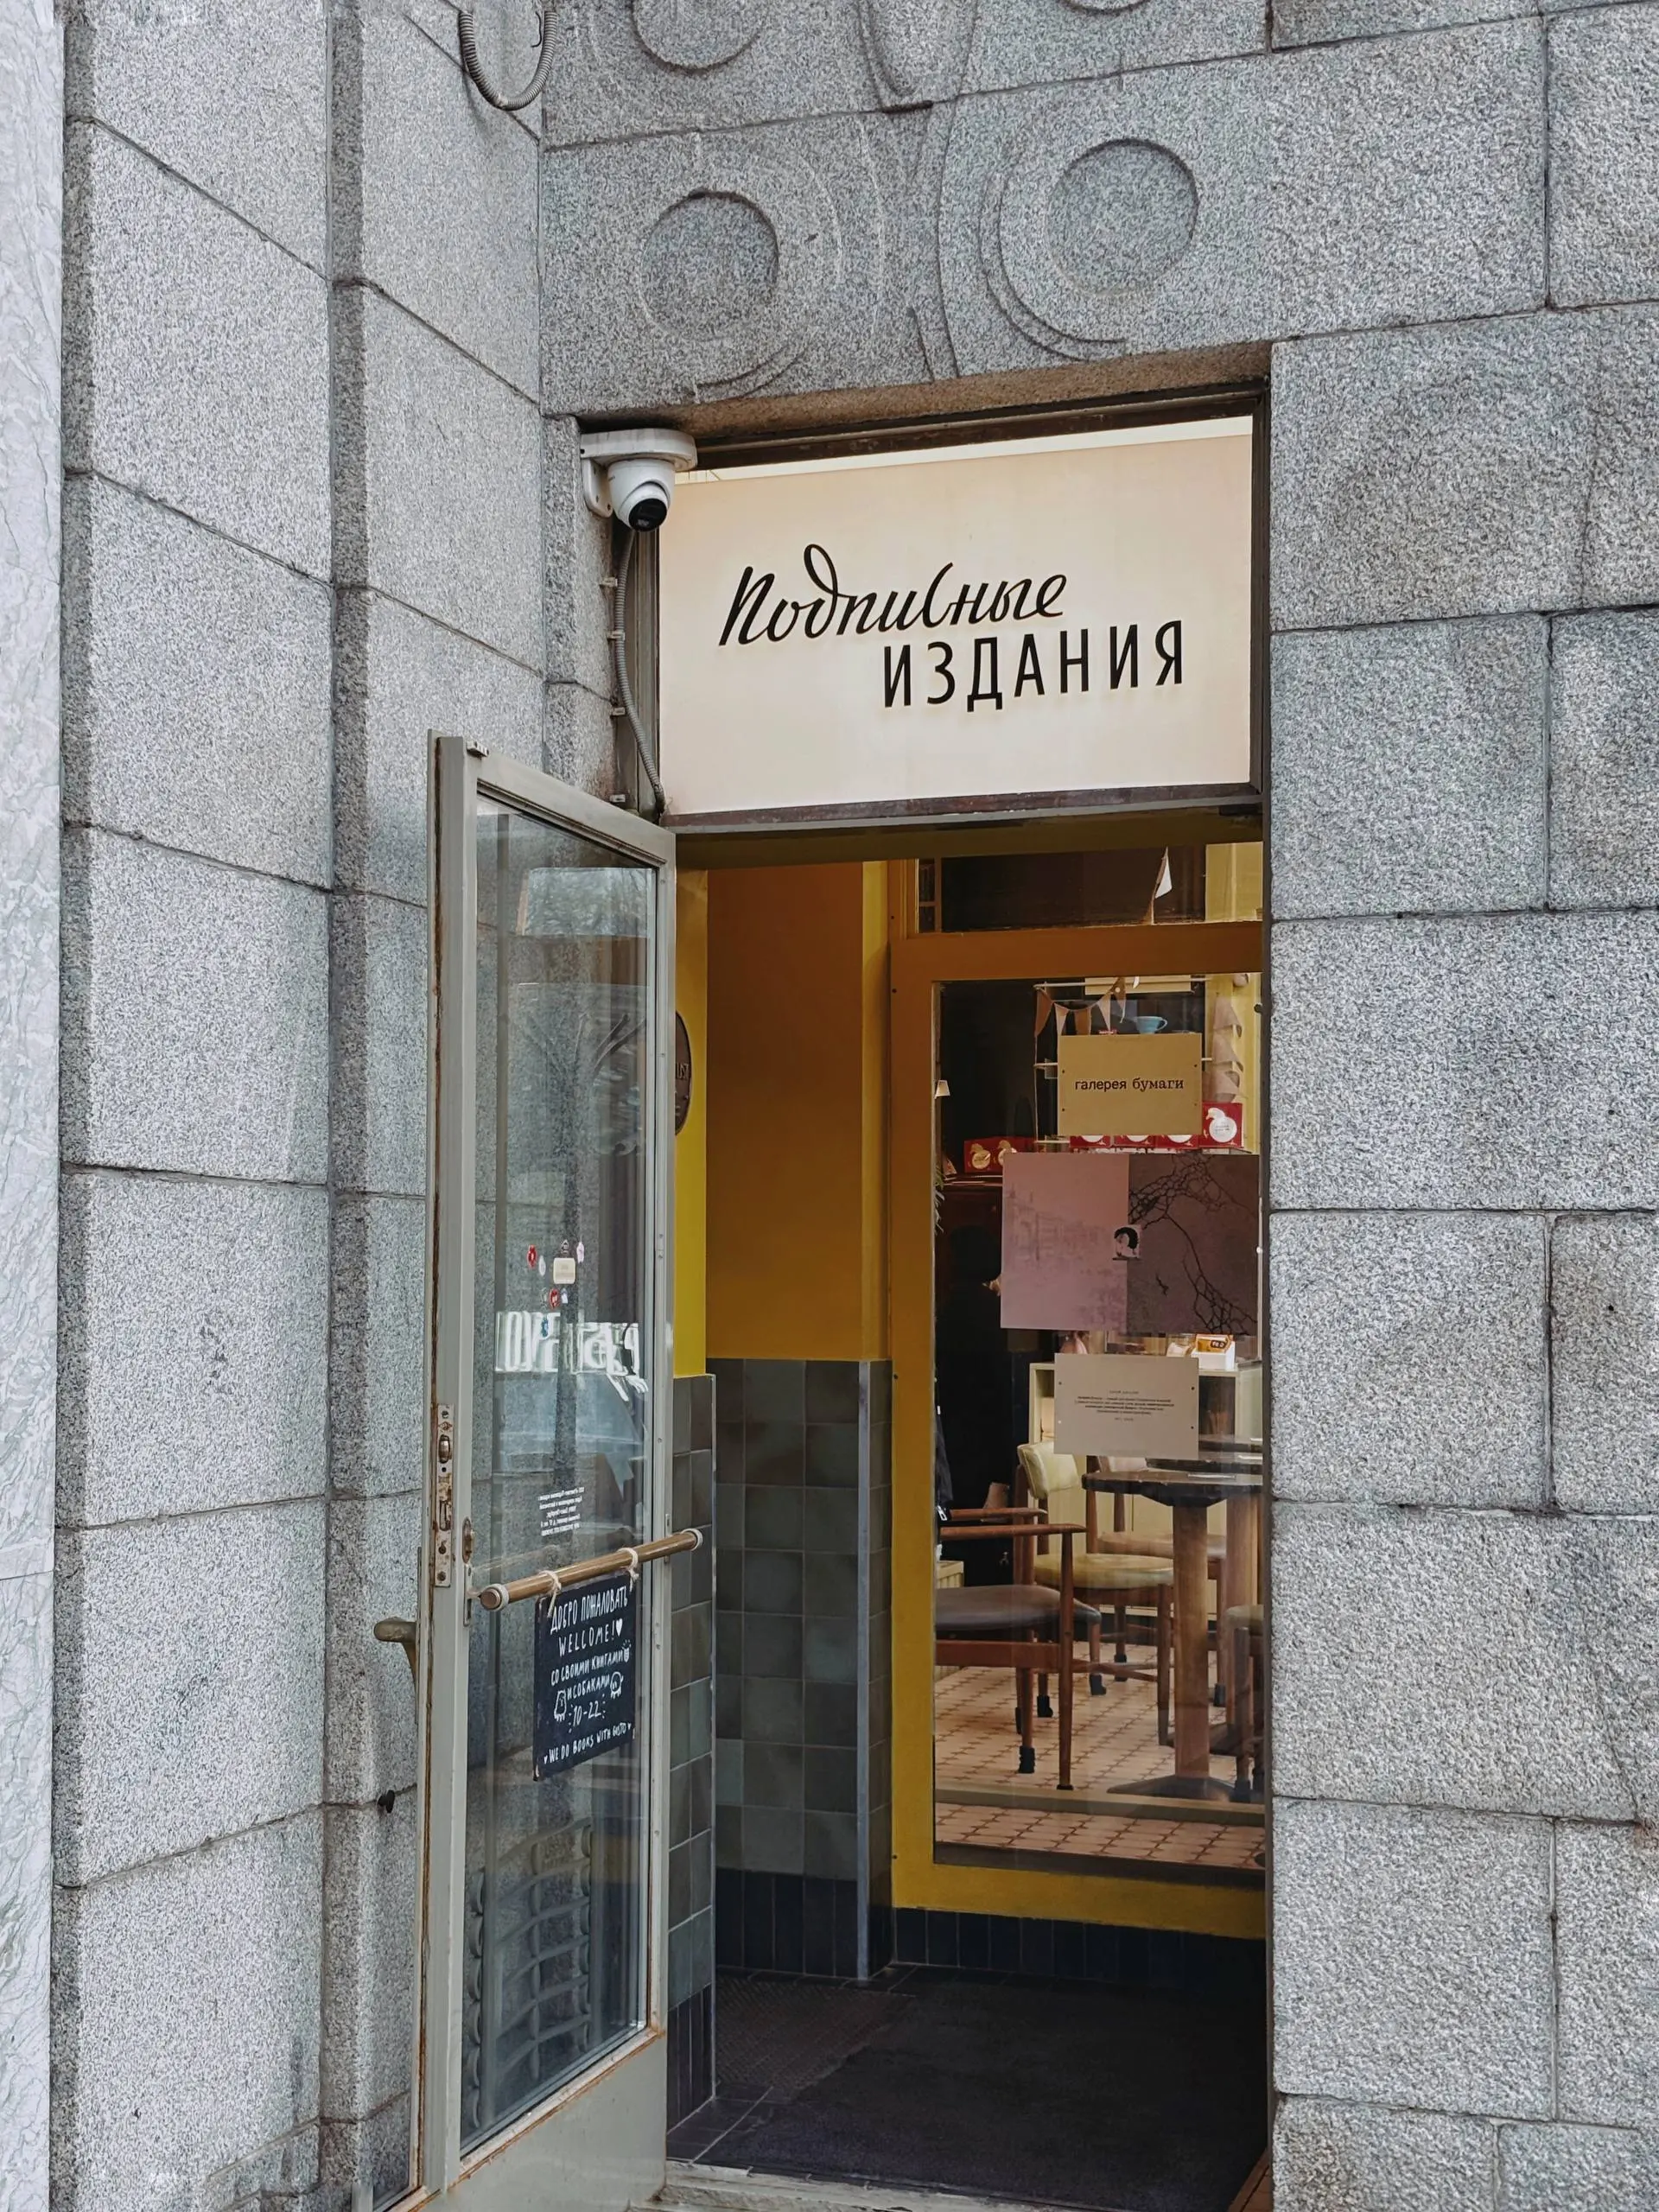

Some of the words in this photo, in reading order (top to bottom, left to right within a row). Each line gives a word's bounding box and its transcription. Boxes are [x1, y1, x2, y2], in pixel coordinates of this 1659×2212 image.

[719, 543, 1067, 646] Подписные
[883, 620, 1183, 712] ИЗДАНИЯ
[1075, 1080, 1127, 1092] галерея
[1132, 1077, 1184, 1092] бумаги
[550, 1599, 578, 1635] ДОБРО
[581, 1586, 628, 1622] ПОЖАЛОВАТЬ
[558, 1620, 615, 1657] WELCOME!
[561, 1659, 590, 1681] СВОИМИ
[591, 1649, 623, 1670] КНИГАМИ
[549, 1747, 559, 1763] WE
[561, 1745, 570, 1760] DO
[572, 1735, 594, 1754] BOOKS
[596, 1727, 611, 1744] WITH
